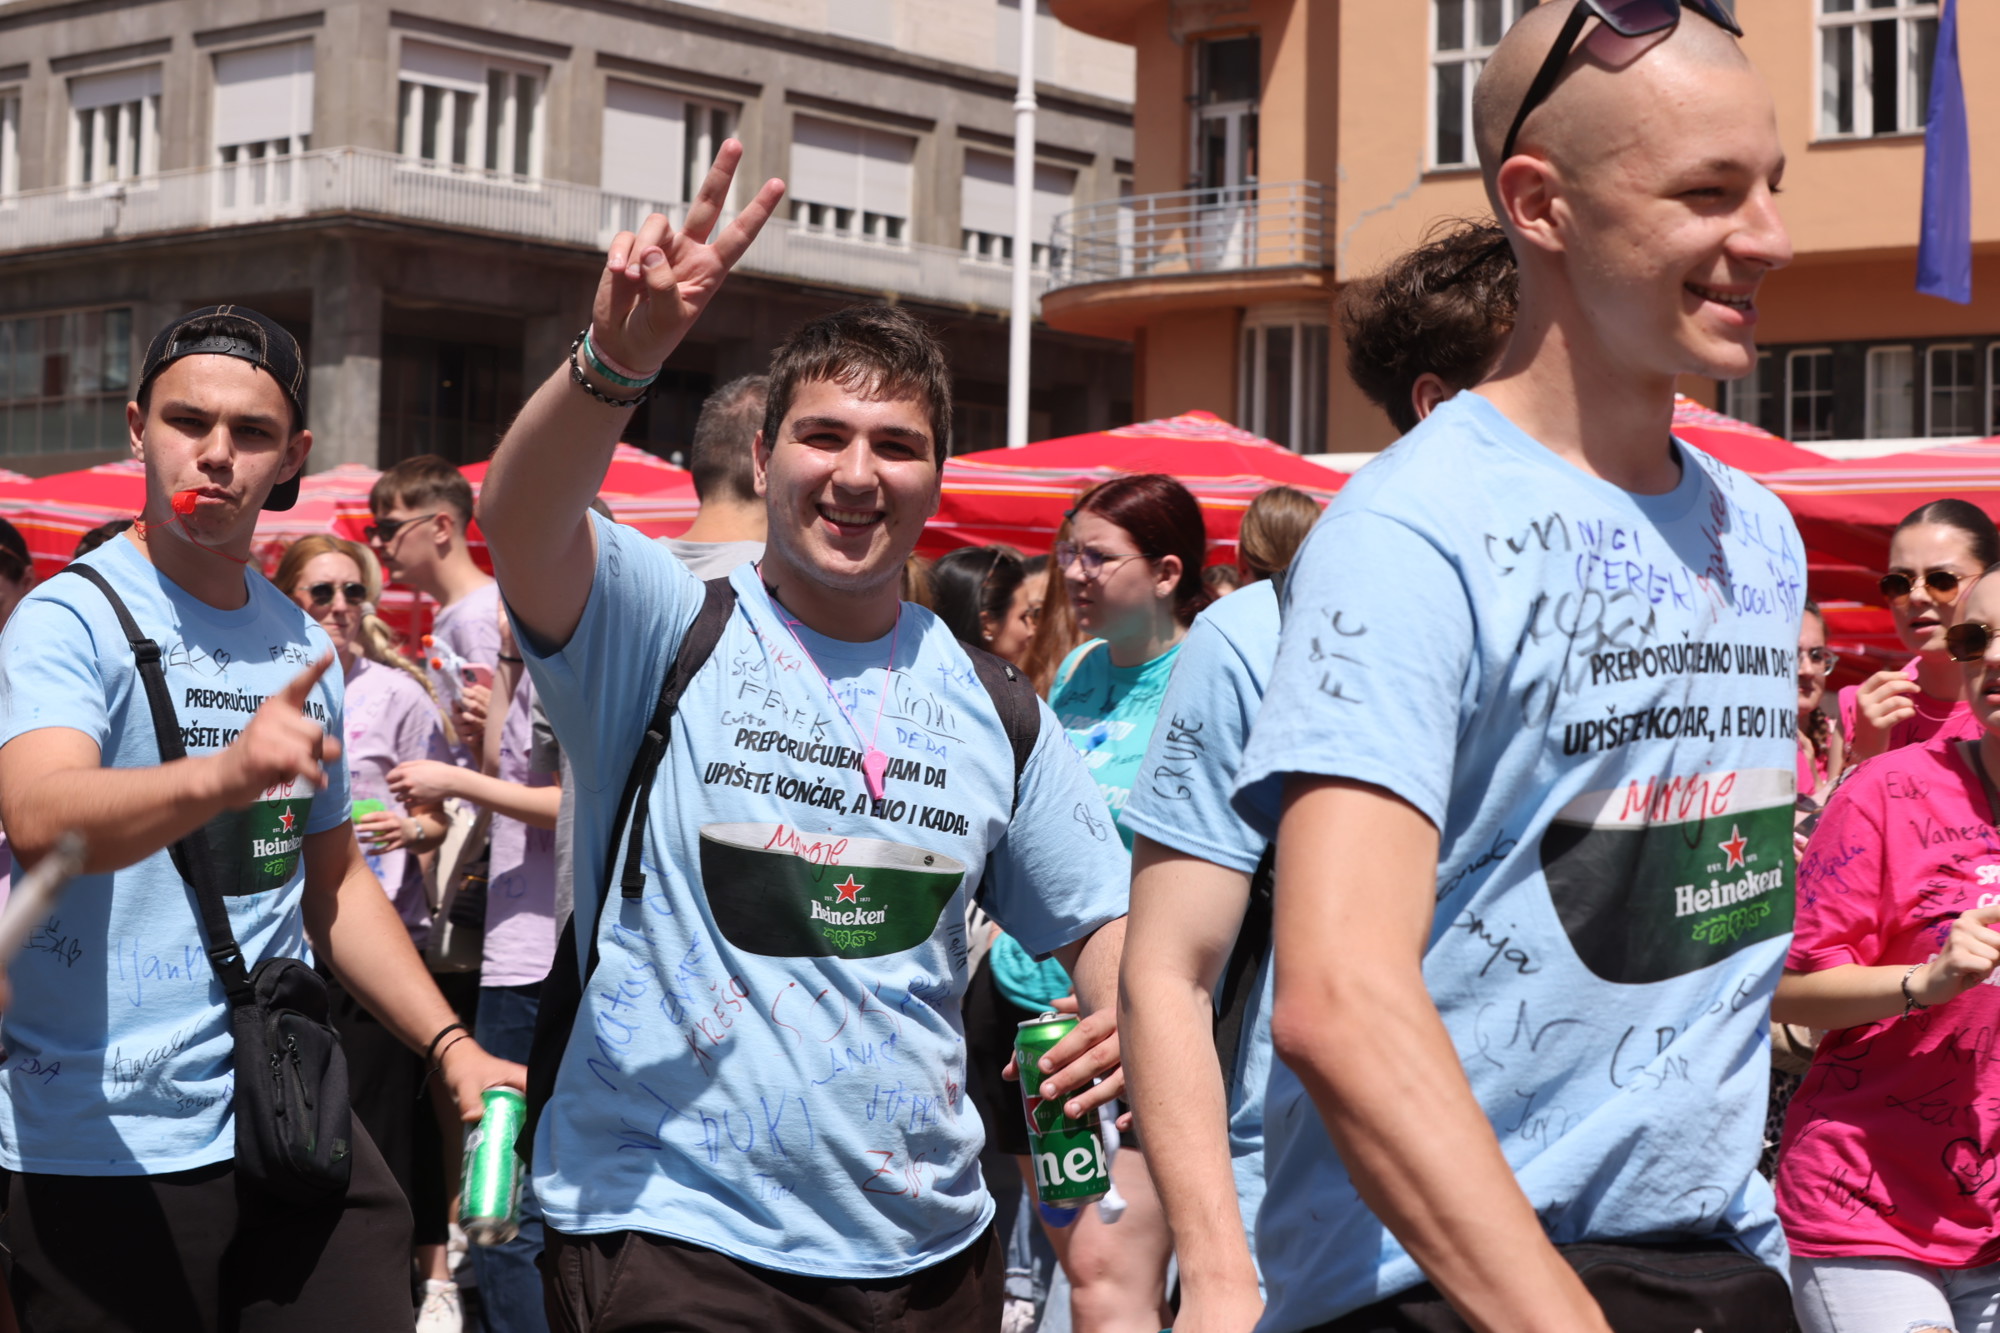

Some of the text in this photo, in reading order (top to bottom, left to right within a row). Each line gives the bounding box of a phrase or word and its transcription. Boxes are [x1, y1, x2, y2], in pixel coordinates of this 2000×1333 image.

[1735, 644, 1769, 675] VAM
[185, 688, 277, 714] PREPORUČUJE
[313, 701, 326, 723] DA
[1721, 706, 1731, 737] A
[1770, 708, 1775, 738] I
[179, 720, 220, 748] PIŠETE
[734, 728, 866, 775] PREPORUČUJEM
[923, 765, 947, 789] DA
[704, 760, 969, 836] UPIŠETE KONČAR, A EVO I KADA:
[1675, 866, 1783, 917] Heineken
[810, 900, 885, 926] Heineken
